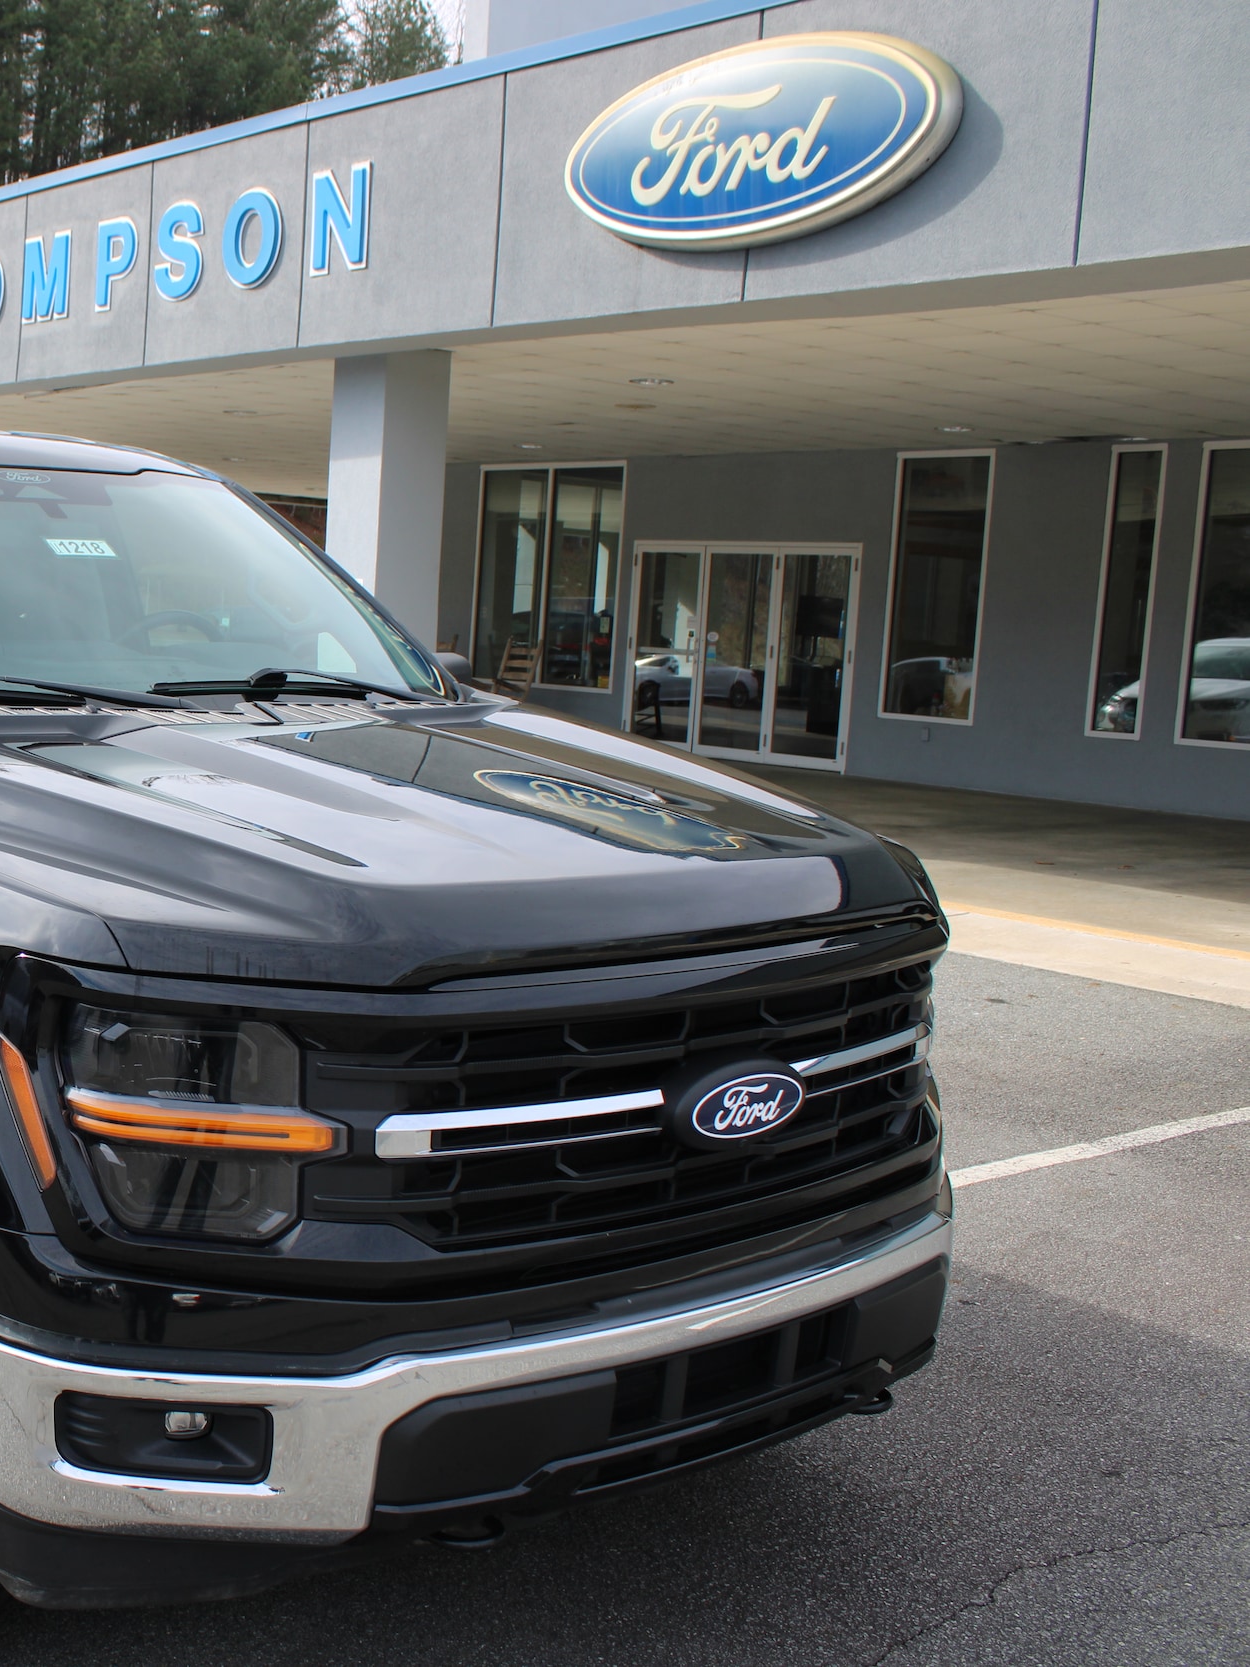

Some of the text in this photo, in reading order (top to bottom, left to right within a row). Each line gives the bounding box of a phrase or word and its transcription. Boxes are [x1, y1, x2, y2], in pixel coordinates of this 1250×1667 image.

[630, 83, 837, 206] Ford
[5, 471, 42, 483] Ford
[58, 540, 106, 555] 1218
[714, 1082, 785, 1131] Ford
